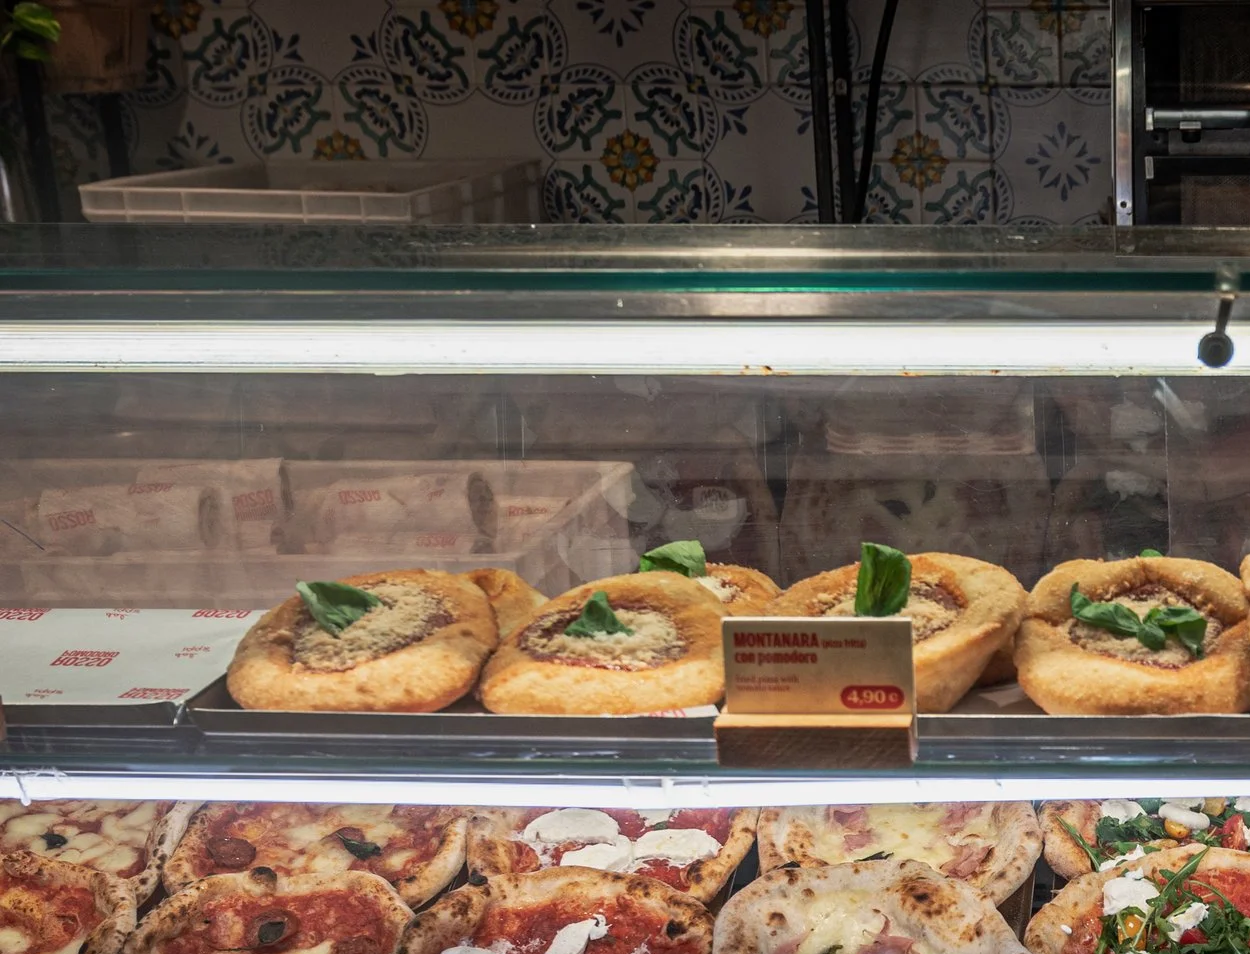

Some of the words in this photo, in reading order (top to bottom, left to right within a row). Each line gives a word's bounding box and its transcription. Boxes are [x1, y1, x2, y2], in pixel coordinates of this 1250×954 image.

[734, 632, 819, 648] MONTANARA
[735, 653, 755, 663] con
[758, 651, 817, 665] pomodoro
